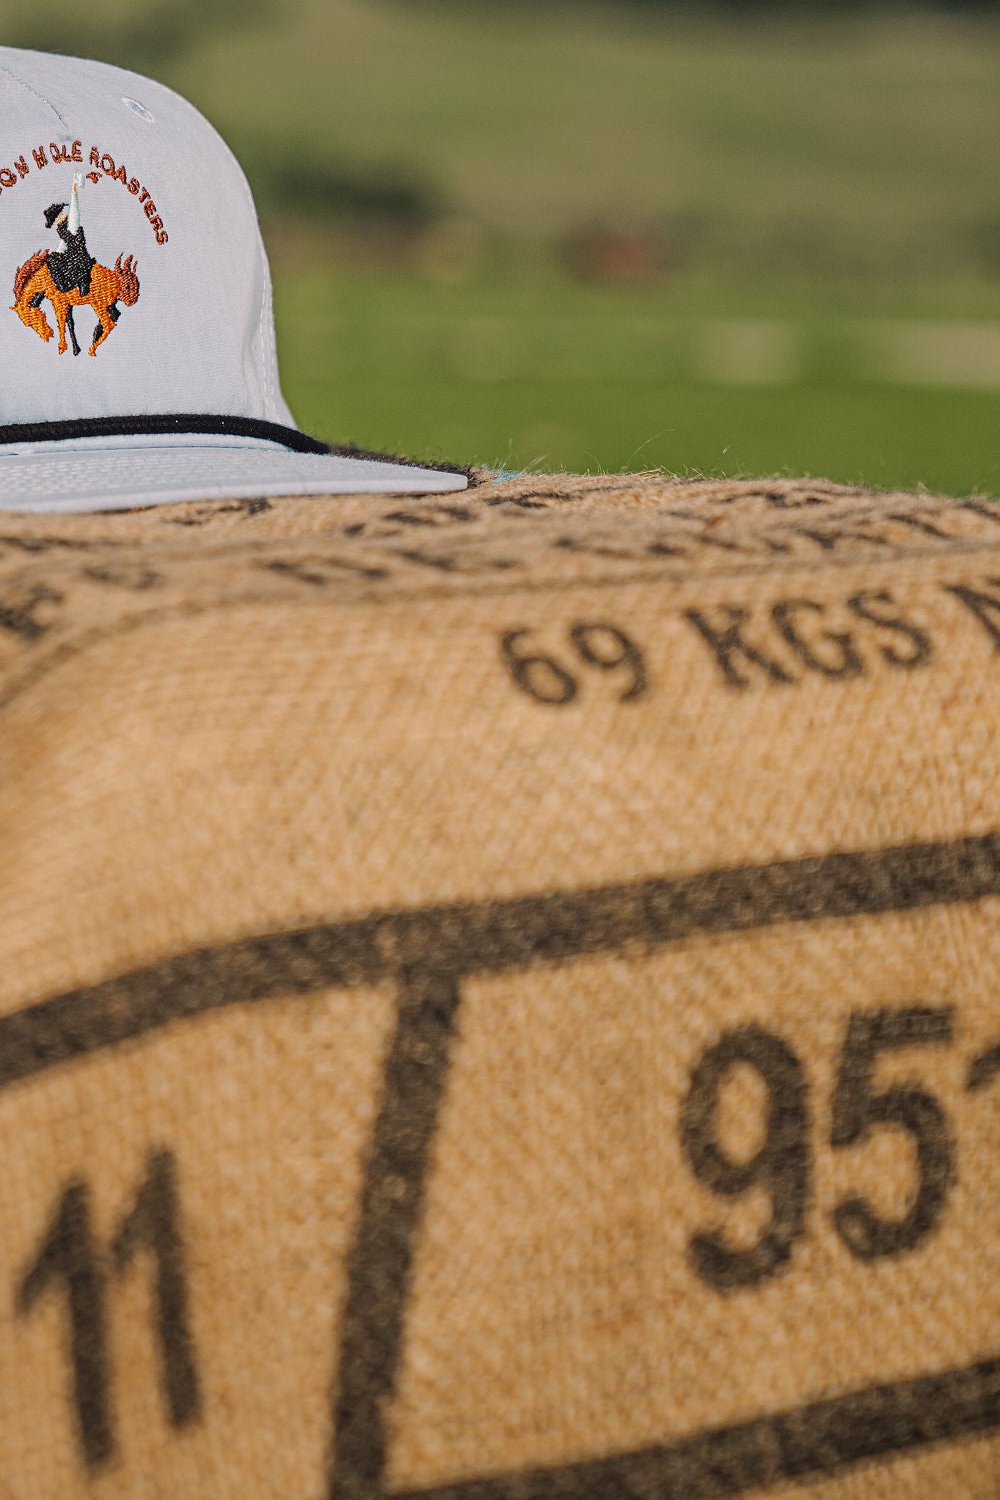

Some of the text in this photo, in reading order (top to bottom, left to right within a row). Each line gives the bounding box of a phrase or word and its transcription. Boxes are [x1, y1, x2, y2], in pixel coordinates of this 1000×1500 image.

[32, 140, 83, 170] HOLE
[89, 146, 169, 246] ROASTERS
[498, 618, 650, 705] 69
[684, 589, 933, 690] KGS
[679, 1002, 1000, 1296] 95
[14, 1140, 202, 1476] 11
